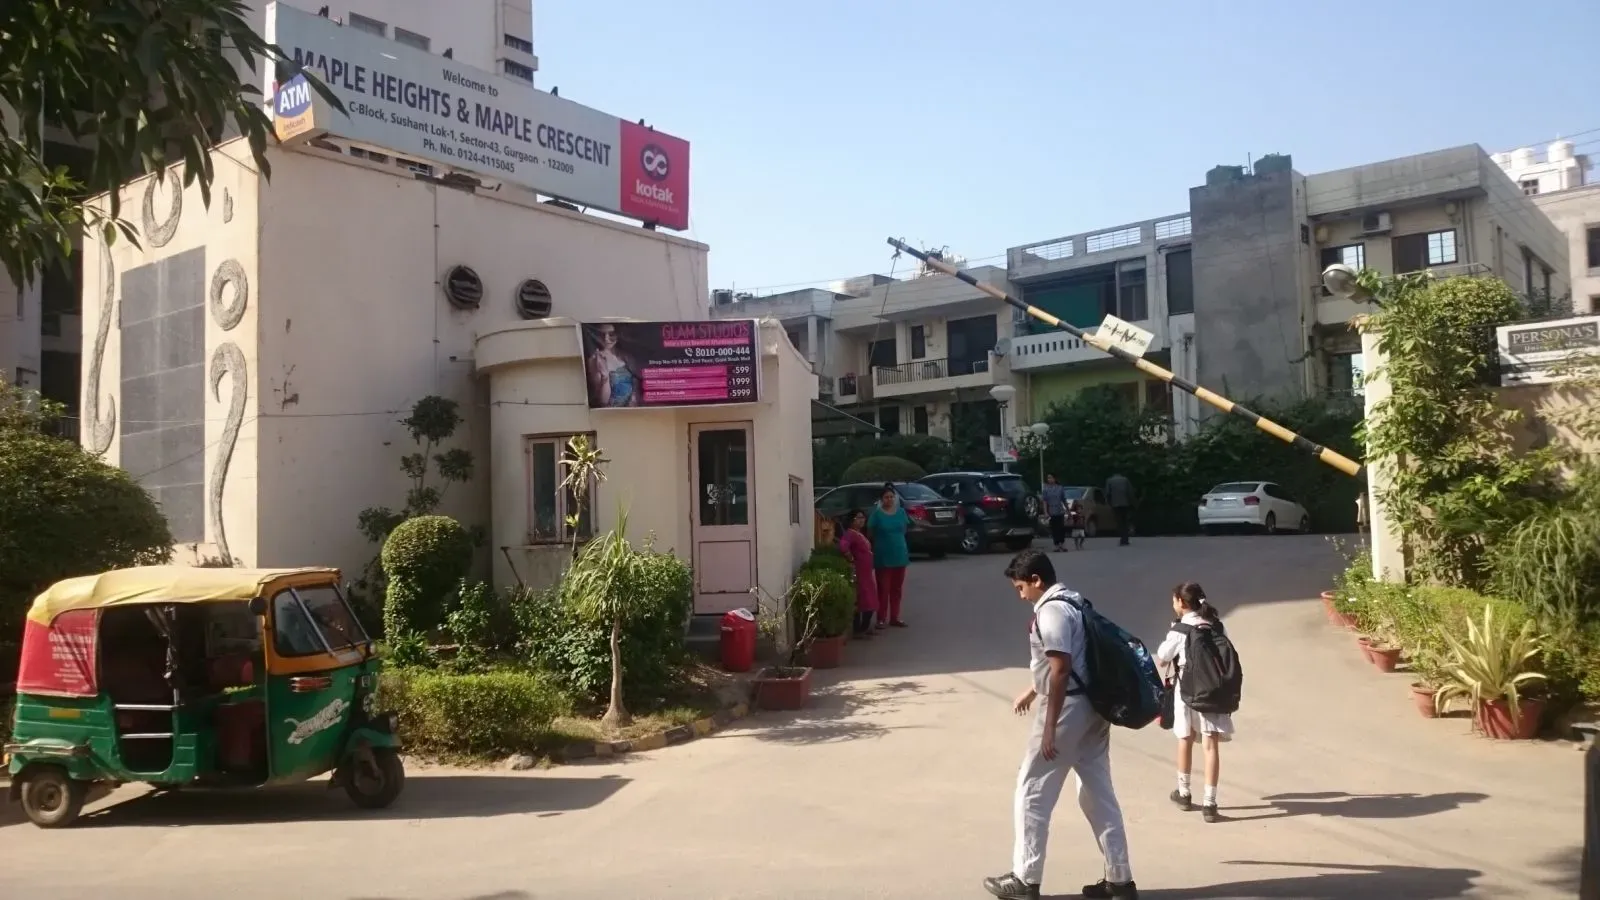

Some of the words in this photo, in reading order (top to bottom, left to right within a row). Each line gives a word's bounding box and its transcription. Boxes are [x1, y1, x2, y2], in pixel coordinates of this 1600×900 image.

[280, 81, 310, 113] ATM
[442, 69, 486, 93] Welcome
[487, 85, 499, 97] to
[294, 47, 366, 94] MAPLE
[372, 71, 451, 118] HEIGHTS
[457, 97, 470, 124] &
[475, 103, 532, 144] MAPLE
[536, 123, 612, 167] CRESCENT
[349, 101, 388, 123] C-Block,
[390, 112, 429, 135] Sushant
[430, 122, 458, 142] Lok-1,
[459, 132, 502, 154] Sector-43,
[503, 145, 539, 165] Gurgaon
[547, 158, 575, 175] 122009
[423, 137, 439, 153] Ph.
[440, 142, 456, 157] No.
[457, 147, 516, 174] 0124-4115045
[636, 178, 674, 204] kotak
[662, 324, 696, 339] GLAM
[700, 322, 749, 338] STUDIOS
[1512, 325, 1595, 344] PERSONA'S
[695, 347, 750, 357] 8010-000-444
